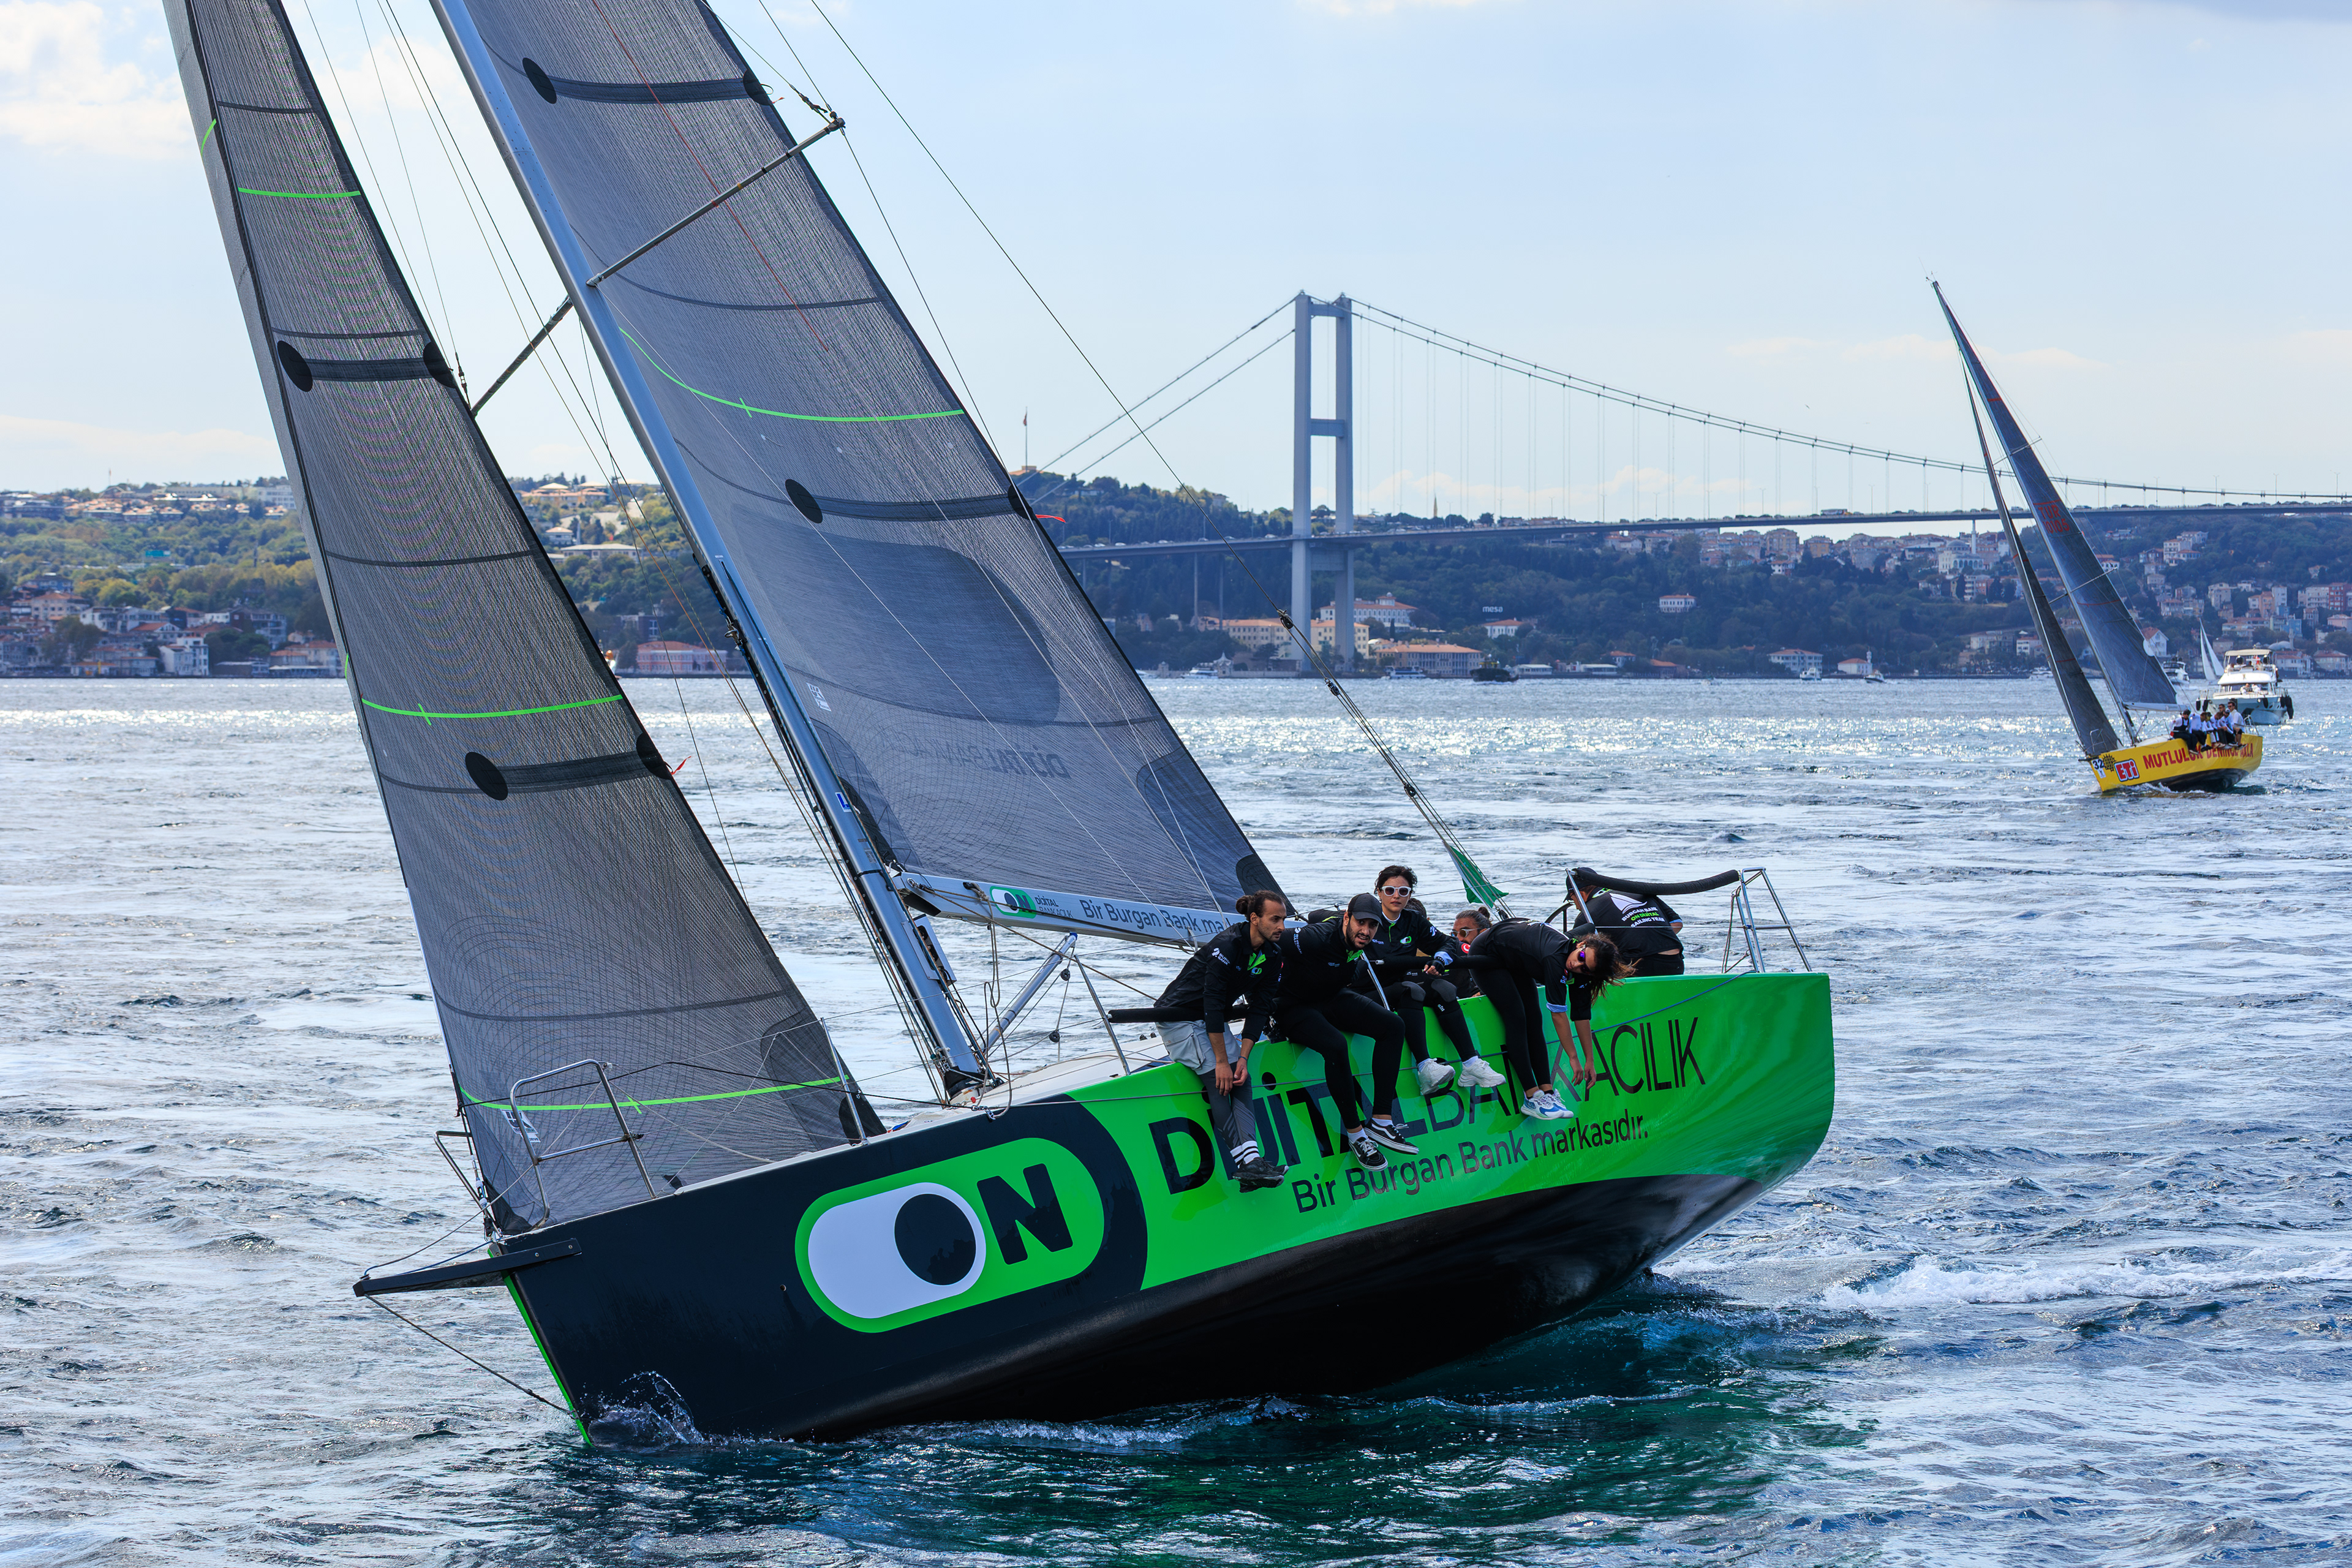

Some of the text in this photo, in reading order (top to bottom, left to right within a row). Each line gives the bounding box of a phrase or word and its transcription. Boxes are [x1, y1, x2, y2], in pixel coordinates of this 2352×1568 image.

[2038, 505, 2061, 519] TUR
[2043, 518, 2070, 534] 10105
[2092, 760, 2104, 769] 32
[1079, 899, 1102, 919] Bir
[1104, 903, 1162, 930] Burgan
[1159, 909, 1202, 932] Bank
[1621, 908, 1645, 921] BURGAN
[1630, 918, 1652, 928] SAILING
[1291, 1108, 1648, 1213] Bir Burgan Bank markasıdır.
[894, 1163, 1074, 1286] ON
